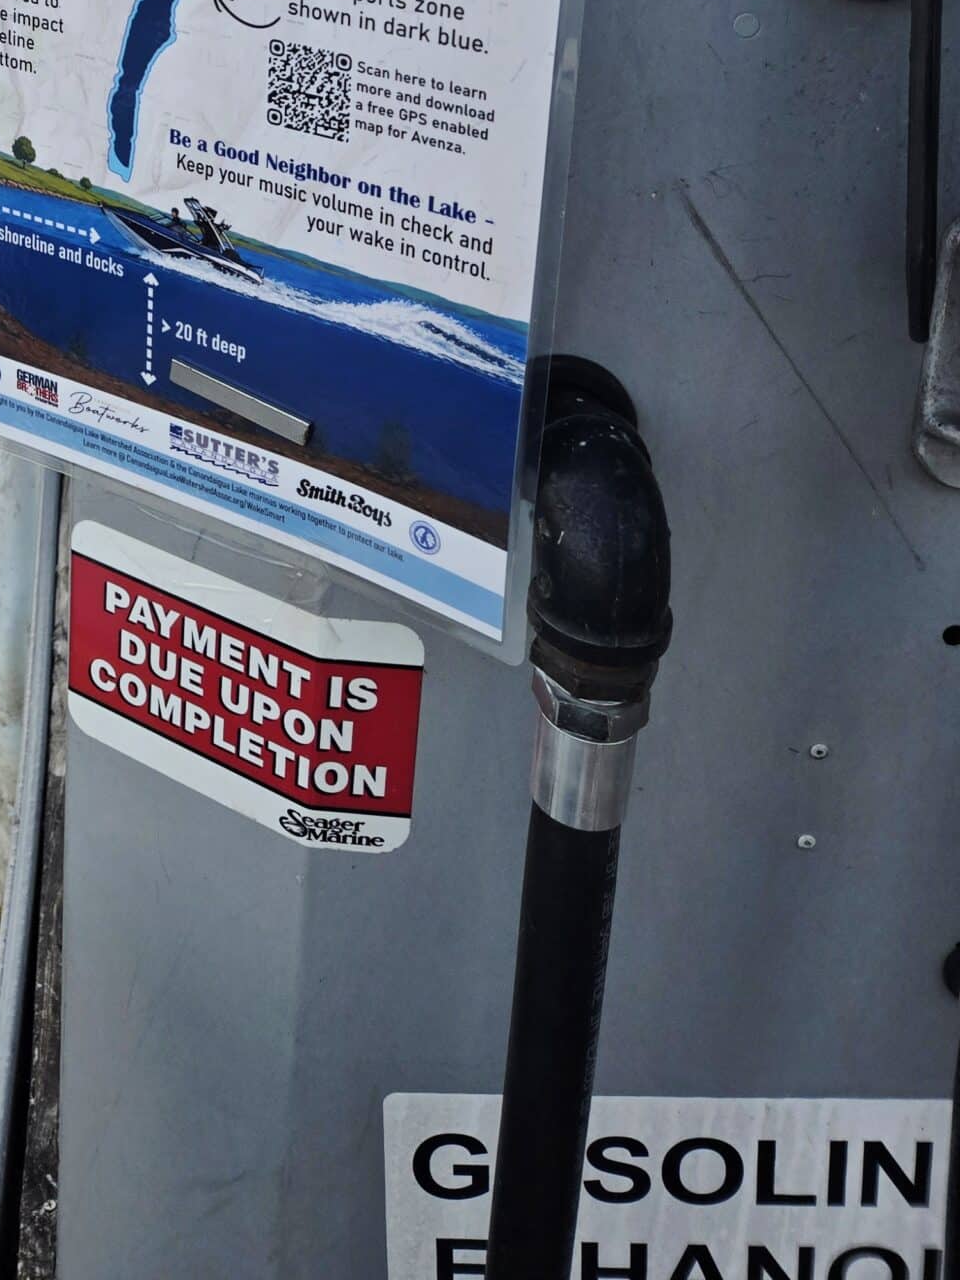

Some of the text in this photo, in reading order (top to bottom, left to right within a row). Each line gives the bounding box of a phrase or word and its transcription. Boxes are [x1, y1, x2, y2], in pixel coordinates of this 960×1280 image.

[14, 8, 63, 33] impact
[288, 0, 488, 53] shown in dark blue.
[415, 0, 464, 20] zone
[358, 61, 486, 100] Scan here to learn
[356, 101, 488, 140] a free GPS enabled
[357, 83, 494, 122] more and download
[355, 120, 465, 154] map for Avenza.
[170, 129, 476, 223] Be a Good Neighbor on the Lake
[177, 153, 493, 256] Keep your music volume in check and
[58, 244, 82, 264] and
[86, 252, 123, 276] docks
[307, 216, 489, 280] your wake in control.
[176, 321, 245, 362] 20 ft deep
[16, 369, 58, 392] GERMAN
[181, 429, 279, 473] SUTTER'S
[296, 478, 346, 507] Smith
[105, 581, 378, 711] PAYMENT IS
[119, 629, 354, 752] DUE UPON
[90, 658, 388, 798] COMPLETION
[280, 809, 365, 838] Seager
[307, 828, 384, 848] Marine
[413, 1133, 934, 1208] GSOLIN
